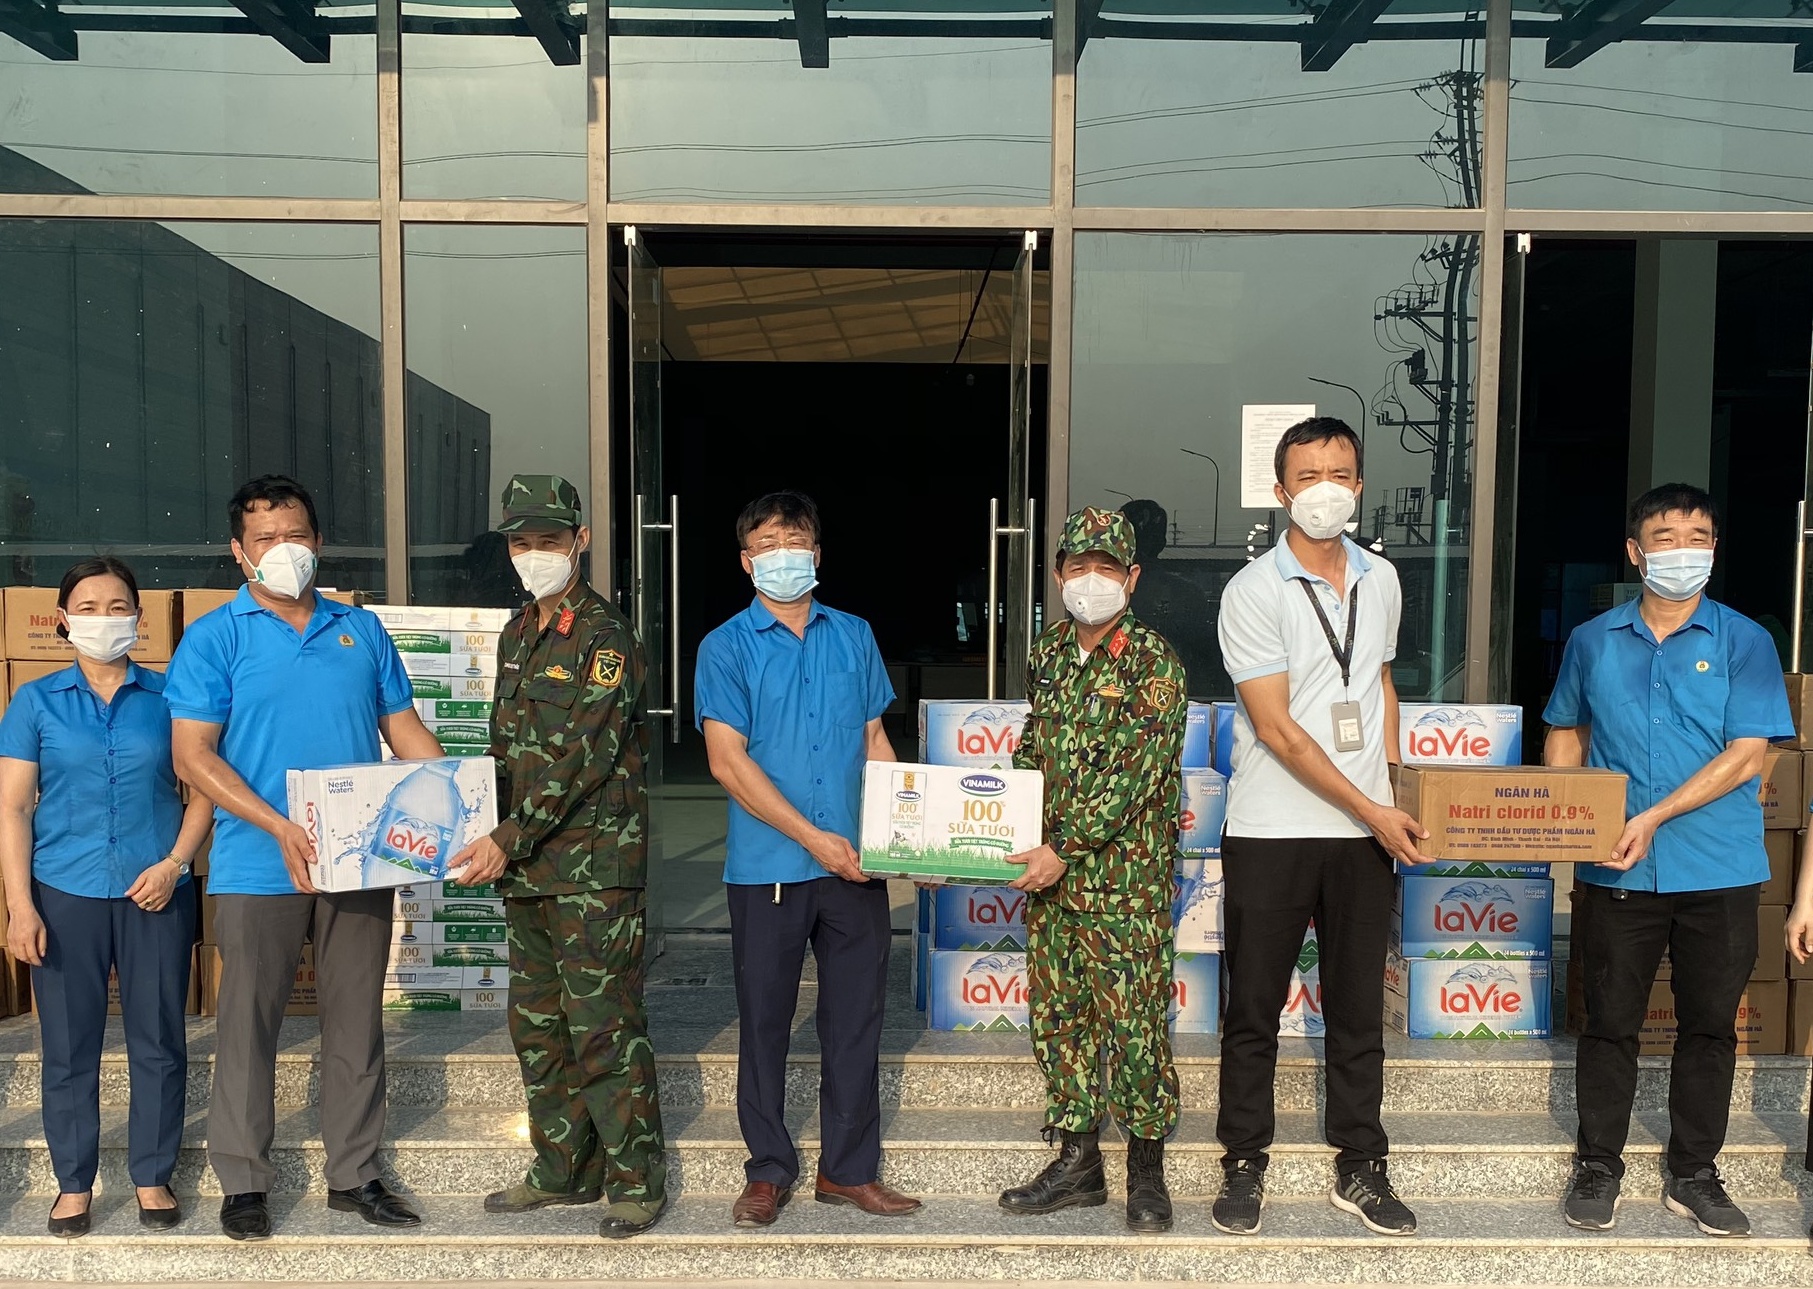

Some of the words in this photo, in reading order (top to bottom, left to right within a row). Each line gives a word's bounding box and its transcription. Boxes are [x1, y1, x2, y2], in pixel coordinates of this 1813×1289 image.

[29, 614, 60, 627] Natr
[958, 725, 1021, 755] laVi
[1409, 727, 1491, 757] laVie
[328, 780, 354, 789] Nestlé
[962, 778, 1004, 790] VINAMILK
[1494, 787, 1530, 798] NGÂN
[1533, 786, 1550, 798] HÀ
[1449, 804, 1491, 820] Natri
[1497, 804, 1546, 820] clorid
[1551, 805, 1595, 820] 0.9%
[948, 821, 975, 835] SỮA
[980, 824, 1015, 838] TƯƠI
[1446, 826, 1466, 834] CÔNG
[386, 826, 438, 860] laVie
[968, 895, 1026, 925] laVi
[1434, 901, 1519, 933] laVie
[1440, 983, 1522, 1014] laVie
